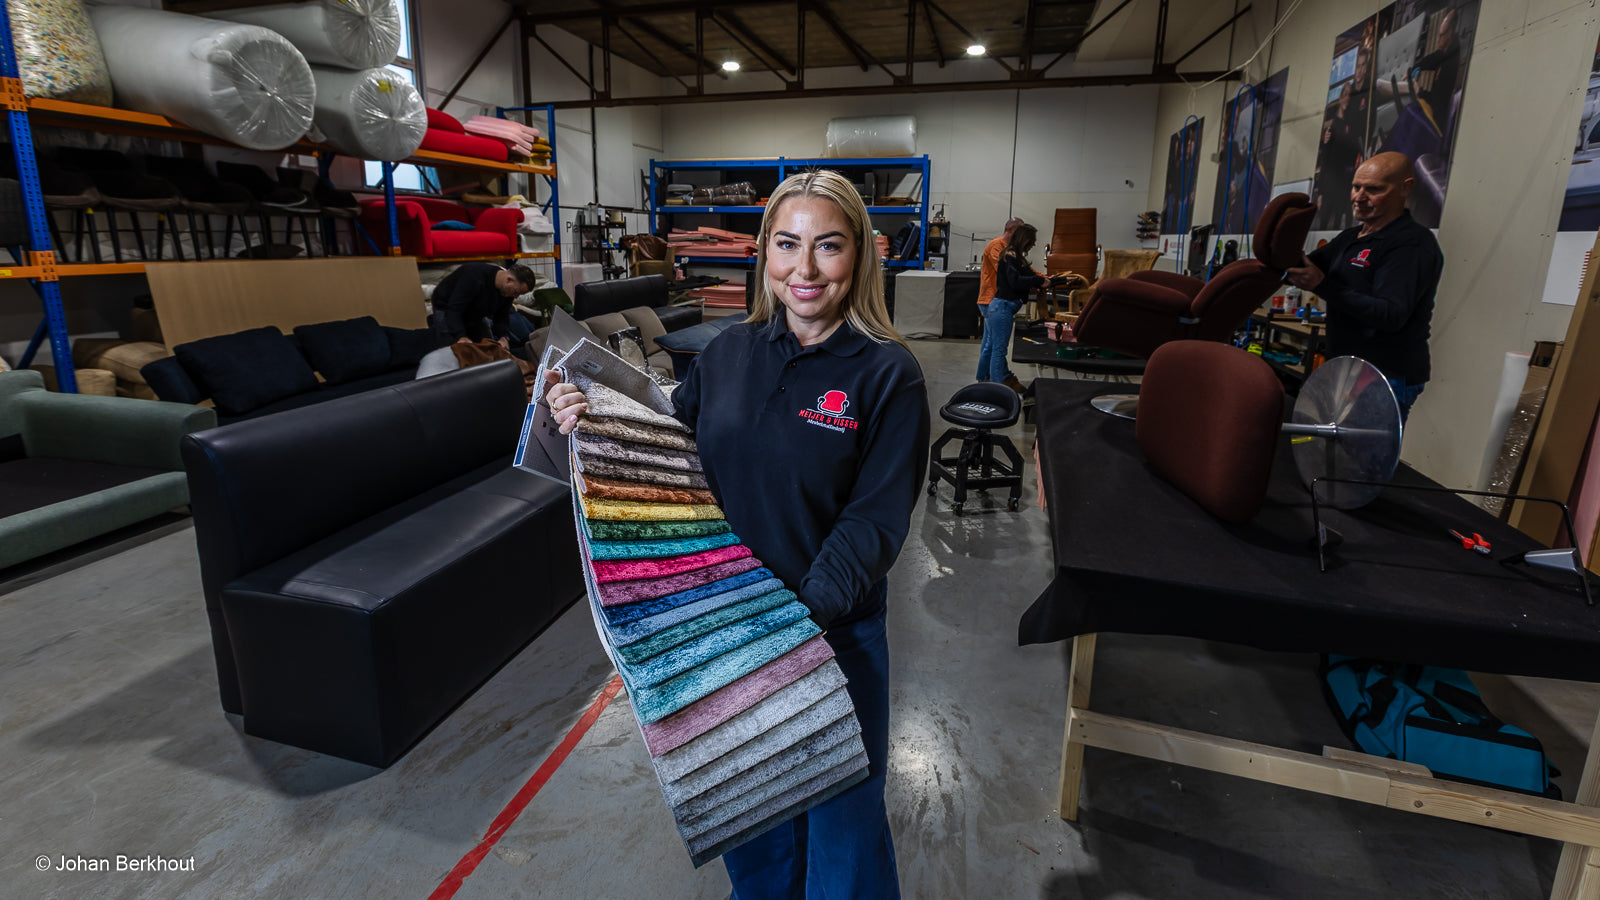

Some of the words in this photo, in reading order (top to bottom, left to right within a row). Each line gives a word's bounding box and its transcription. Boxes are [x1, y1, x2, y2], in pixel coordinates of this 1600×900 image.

[566, 221, 580, 233] Pla
[798, 409, 825, 422] MEIJER
[833, 417, 859, 430] VISSER
